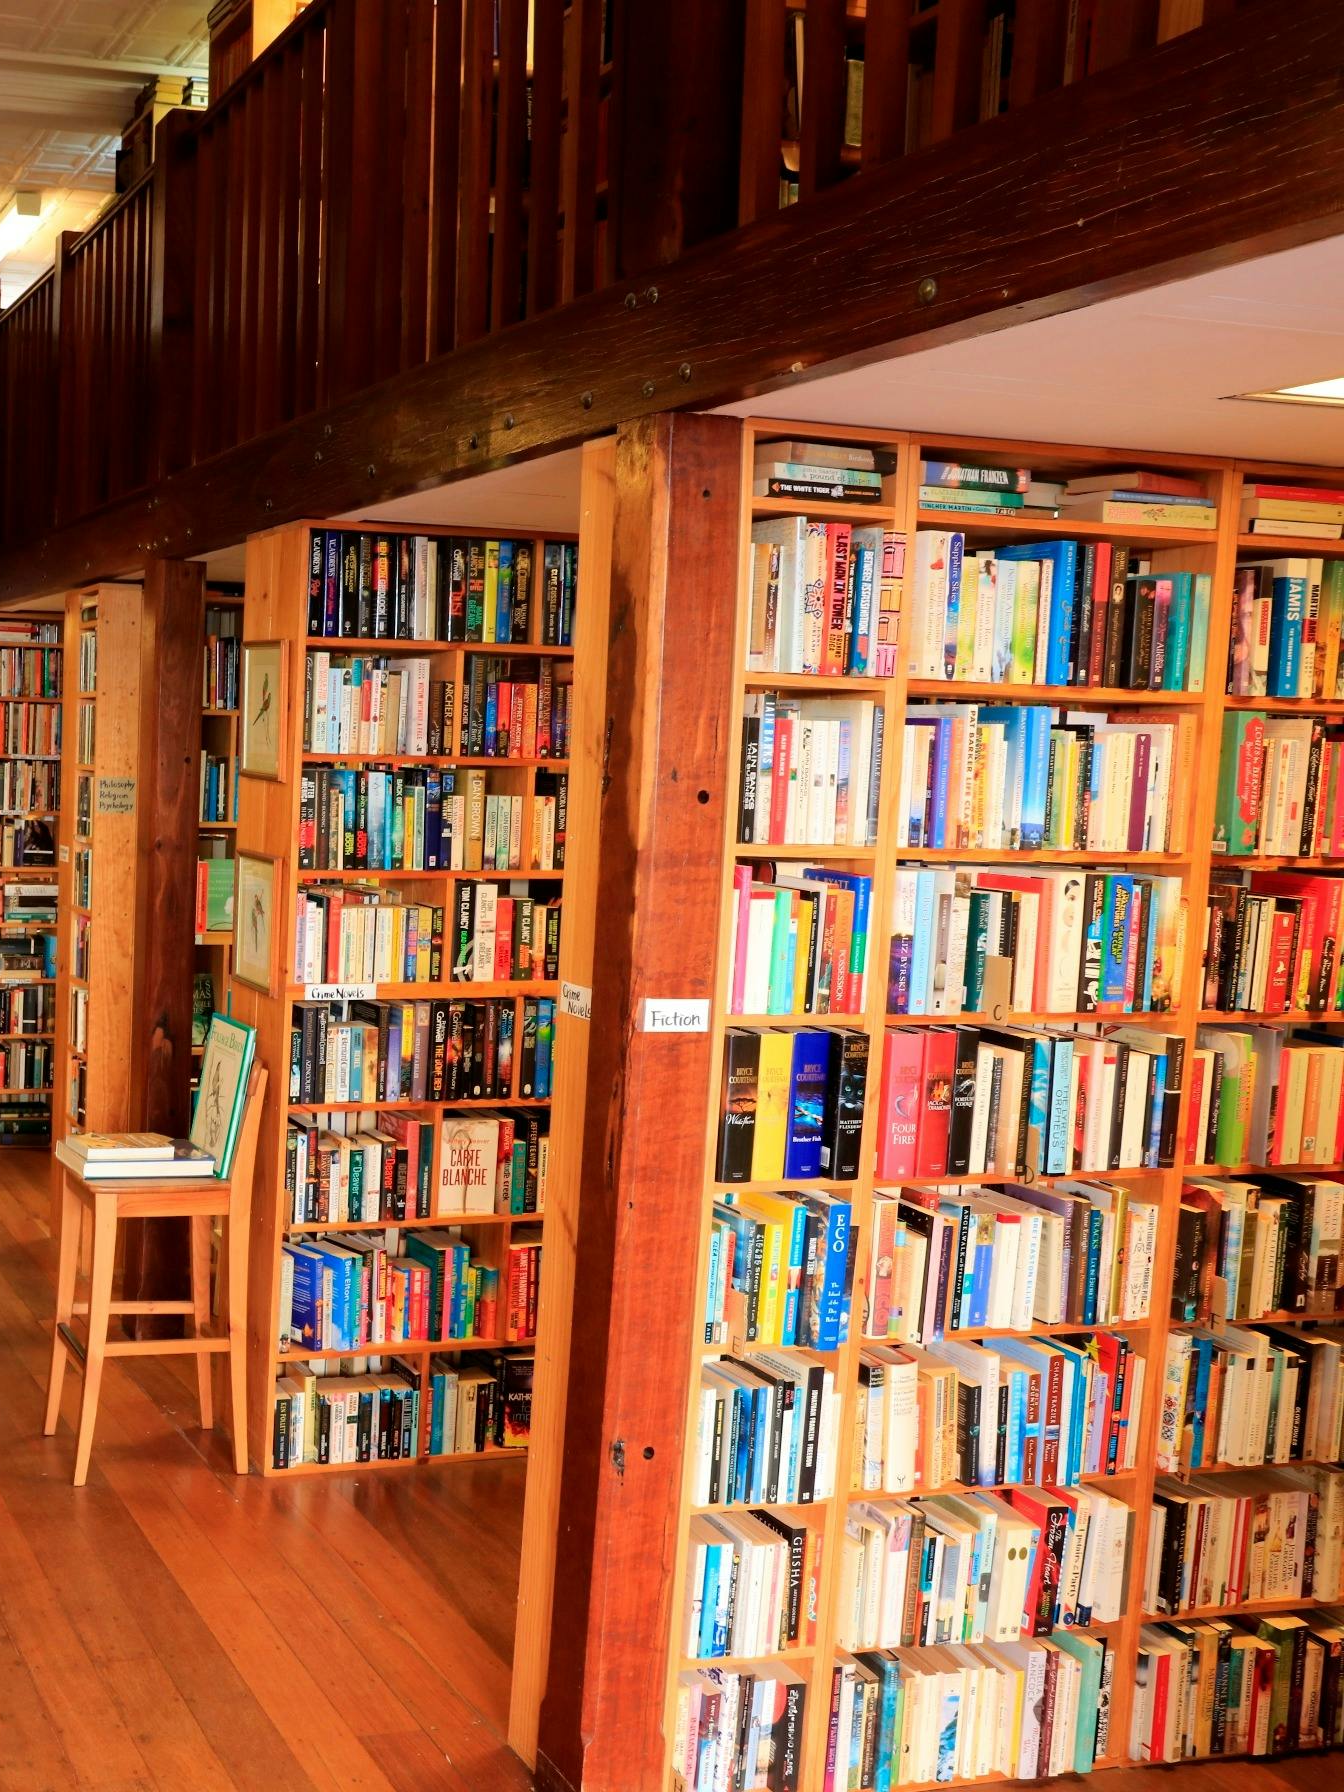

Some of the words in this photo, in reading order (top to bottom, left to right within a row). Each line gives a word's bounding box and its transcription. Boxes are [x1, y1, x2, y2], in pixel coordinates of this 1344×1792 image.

[978, 468, 1009, 484] FRANZEN
[793, 484, 810, 492] WHITE
[810, 485, 830, 494] TIGER
[379, 541, 389, 556] BEN
[835, 535, 849, 559] LAST
[950, 541, 962, 578] Sapphire
[378, 557, 389, 579] ELTON
[835, 561, 847, 580] MAN
[862, 550, 875, 582] BETWEEN
[1065, 545, 1074, 577] MONICA
[551, 568, 559, 586] CLIVE
[834, 582, 846, 595] IN
[377, 579, 388, 616] GRIDLOCK
[451, 591, 464, 616] DUST
[950, 581, 960, 604] Skies
[1309, 584, 1320, 619] MARTIN
[468, 600, 477, 631] GREANEY
[830, 598, 844, 630] TOWER
[858, 582, 872, 635] ASSASSINATIONS
[1307, 620, 1318, 644] AMIS
[1154, 642, 1164, 674] Allende
[444, 682, 454, 718] ARCHER
[462, 684, 470, 704] JEFFREY
[516, 697, 524, 722] JEFFREY
[765, 702, 776, 723] IAIN
[969, 710, 977, 728] PAT
[515, 722, 524, 749] ARCHER
[876, 713, 885, 734] JOHN
[750, 742, 758, 768] IAIN
[762, 729, 774, 765] BANKS
[873, 737, 883, 777] BANVILLE
[966, 732, 976, 772] BARKER
[99, 779, 136, 791] Philosophy
[99, 791, 129, 801] Religion
[301, 776, 309, 803] AMERICA
[307, 781, 315, 799] AFTER
[472, 779, 483, 800] DAN
[558, 786, 568, 809] SANDRA
[747, 771, 758, 810] BANKS
[470, 801, 482, 837] BROWN
[489, 811, 497, 824] DAN
[502, 811, 510, 824] DAN
[557, 809, 567, 831] BROWN
[300, 806, 308, 856] BIRMINGHAM
[488, 825, 497, 849] BROWN
[501, 824, 509, 849] BROWN
[356, 831, 364, 857] BOOTH
[460, 886, 471, 902] TOM
[1096, 879, 1105, 908] MICHAEL
[1120, 888, 1130, 921] AMAZING
[1238, 889, 1247, 912] TRACY
[459, 902, 470, 930] CLANCY
[522, 901, 533, 917] TOM
[521, 917, 532, 944] CLANCY
[1234, 913, 1244, 952] CHEVALIER
[477, 942, 488, 970] GREANEY
[900, 937, 910, 954] LIZ
[977, 953, 986, 965] Liz
[836, 949, 848, 1001] POSSESSION
[897, 956, 909, 992] BYRSKI
[975, 966, 986, 992] Byrski
[312, 988, 335, 999] Crime
[336, 985, 364, 999] Novels
[562, 984, 581, 1000] Crime
[567, 1002, 592, 1019] Novels
[650, 1010, 701, 1028] Fiction
[435, 1010, 445, 1043] Cornwell
[500, 1008, 509, 1039] Cornwell
[435, 1044, 444, 1058] THE
[304, 1059, 313, 1093] AZINCOURT
[1216, 1056, 1224, 1073] ANITA
[1061, 1084, 1070, 1107] THE
[891, 1122, 916, 1133] FOUR
[1052, 1089, 1063, 1148] ORPHEUS
[1060, 1109, 1068, 1138] LYRE
[503, 1126, 512, 1151] DEAVER
[529, 1121, 538, 1144] JEFFERY
[892, 1134, 916, 1145] FIRES
[320, 1154, 328, 1178] DAVIS
[450, 1149, 482, 1167] CARTE
[528, 1145, 537, 1167] DEAVER
[351, 1166, 363, 1195] Deaver
[384, 1159, 396, 1190] Deaver
[396, 1163, 407, 1196] DEAVER
[442, 1168, 488, 1186] BLANCHE
[1065, 1202, 1073, 1223] ANNE
[1083, 1210, 1091, 1227] Anne
[748, 1225, 756, 1238] The
[832, 1214, 846, 1253] ECO
[958, 1209, 970, 1258] ANGELWALK
[1080, 1229, 1090, 1253] Enright
[1091, 1216, 1101, 1249] TRACKS
[379, 1252, 387, 1270] JANET
[744, 1240, 755, 1268] Thompson
[807, 1237, 818, 1260] NUMERO
[1027, 1243, 1038, 1278] EASTON
[344, 1260, 353, 1277] Ben
[519, 1252, 529, 1272] JANET
[806, 1261, 816, 1276] ZERO
[343, 1280, 352, 1301] Elton
[378, 1270, 387, 1299] EVANOVICH
[518, 1273, 528, 1307] EVANOVICH
[752, 1267, 761, 1293] Street
[1024, 1280, 1033, 1304] ELLIS
[1052, 1361, 1061, 1394] CHARLES
[279, 1402, 287, 1413] KEN
[809, 1390, 819, 1416] JONATHAN
[1027, 1380, 1037, 1421] MOUNTAIN
[1049, 1396, 1059, 1424] FRAZIER
[278, 1413, 287, 1434] FOLLETT
[1294, 1406, 1302, 1425] OLIVIA
[807, 1417, 817, 1441] FRANZEN
[805, 1444, 815, 1468] FREEDOM
[1046, 1512, 1063, 1550] Frozen
[1054, 1530, 1063, 1542] The
[1073, 1528, 1087, 1564] Upstairs
[790, 1536, 803, 1588] GEISHA
[1042, 1552, 1057, 1586] Heart
[1175, 1529, 1187, 1592] HOURGLASS
[1280, 1543, 1290, 1583] GREGORY
[1286, 1544, 1297, 1581] PHILIPPA
[1066, 1571, 1080, 1598] Party
[1027, 1656, 1038, 1702] HANCOCK
[1036, 1664, 1045, 1695] SHEILA
[1176, 1677, 1185, 1697] Mayor
[1220, 1662, 1231, 1700] JOANNE
[1216, 1702, 1227, 1738] HARRIS
